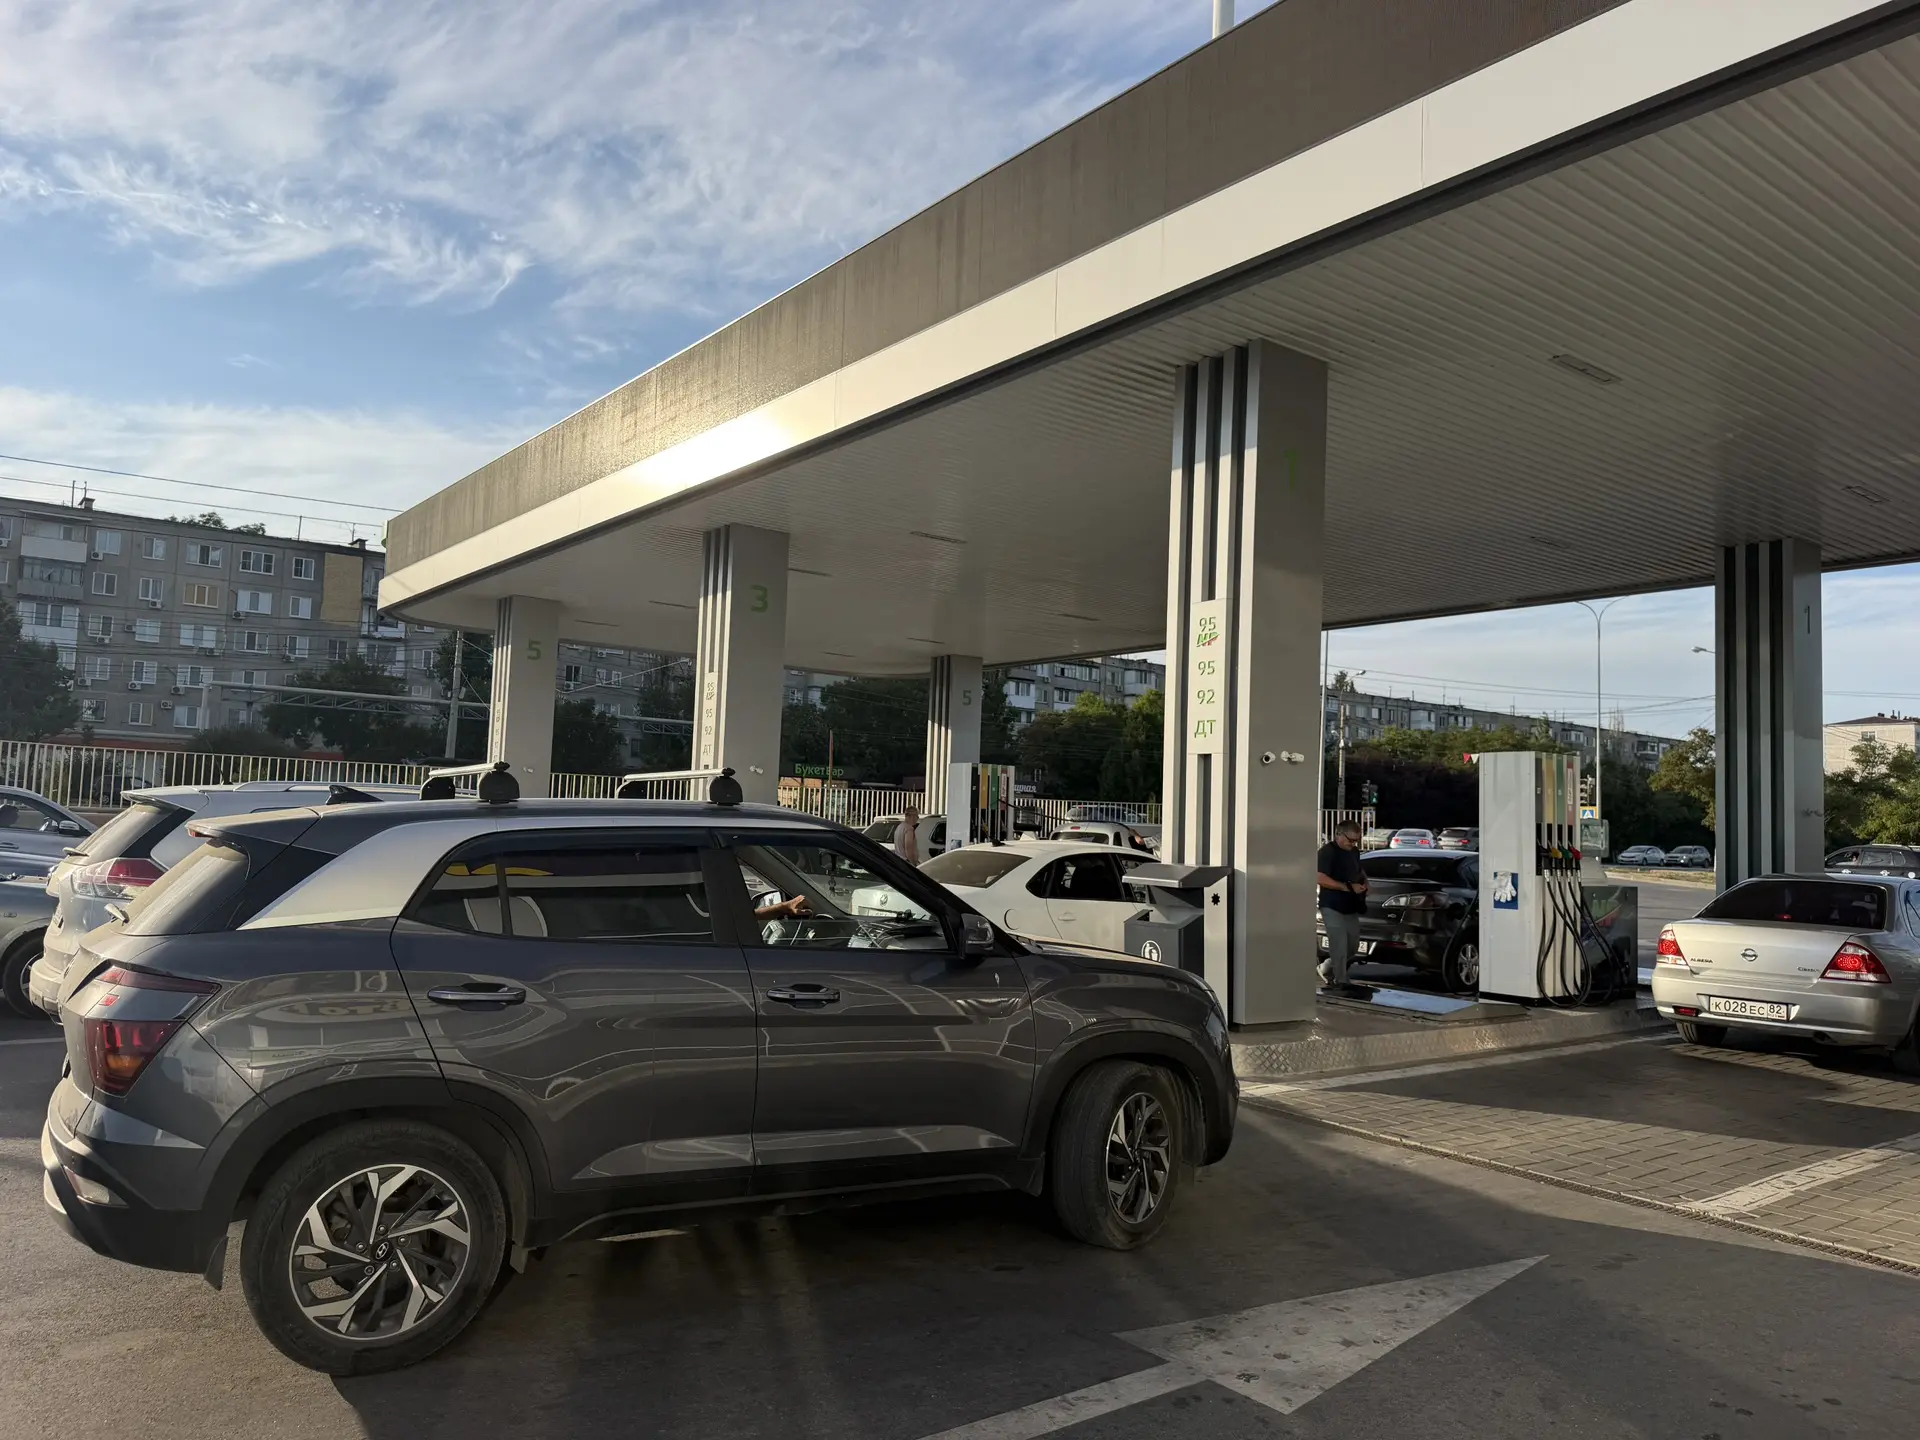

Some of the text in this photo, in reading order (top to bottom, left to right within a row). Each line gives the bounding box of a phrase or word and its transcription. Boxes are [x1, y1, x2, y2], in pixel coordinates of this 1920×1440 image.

[1284, 449, 1298, 490] 1
[750, 584, 768, 613] 3
[1199, 616, 1216, 632] 95
[1803, 604, 1811, 634] 1
[527, 638, 542, 660] 5
[1198, 660, 1215, 676] 95
[962, 689, 972, 706] 5
[1197, 689, 1215, 705] 92
[705, 708, 713, 718] 95
[704, 725, 712, 736] 92
[1194, 719, 1217, 739] ДТ
[1768, 1004, 1782, 1015] 82
